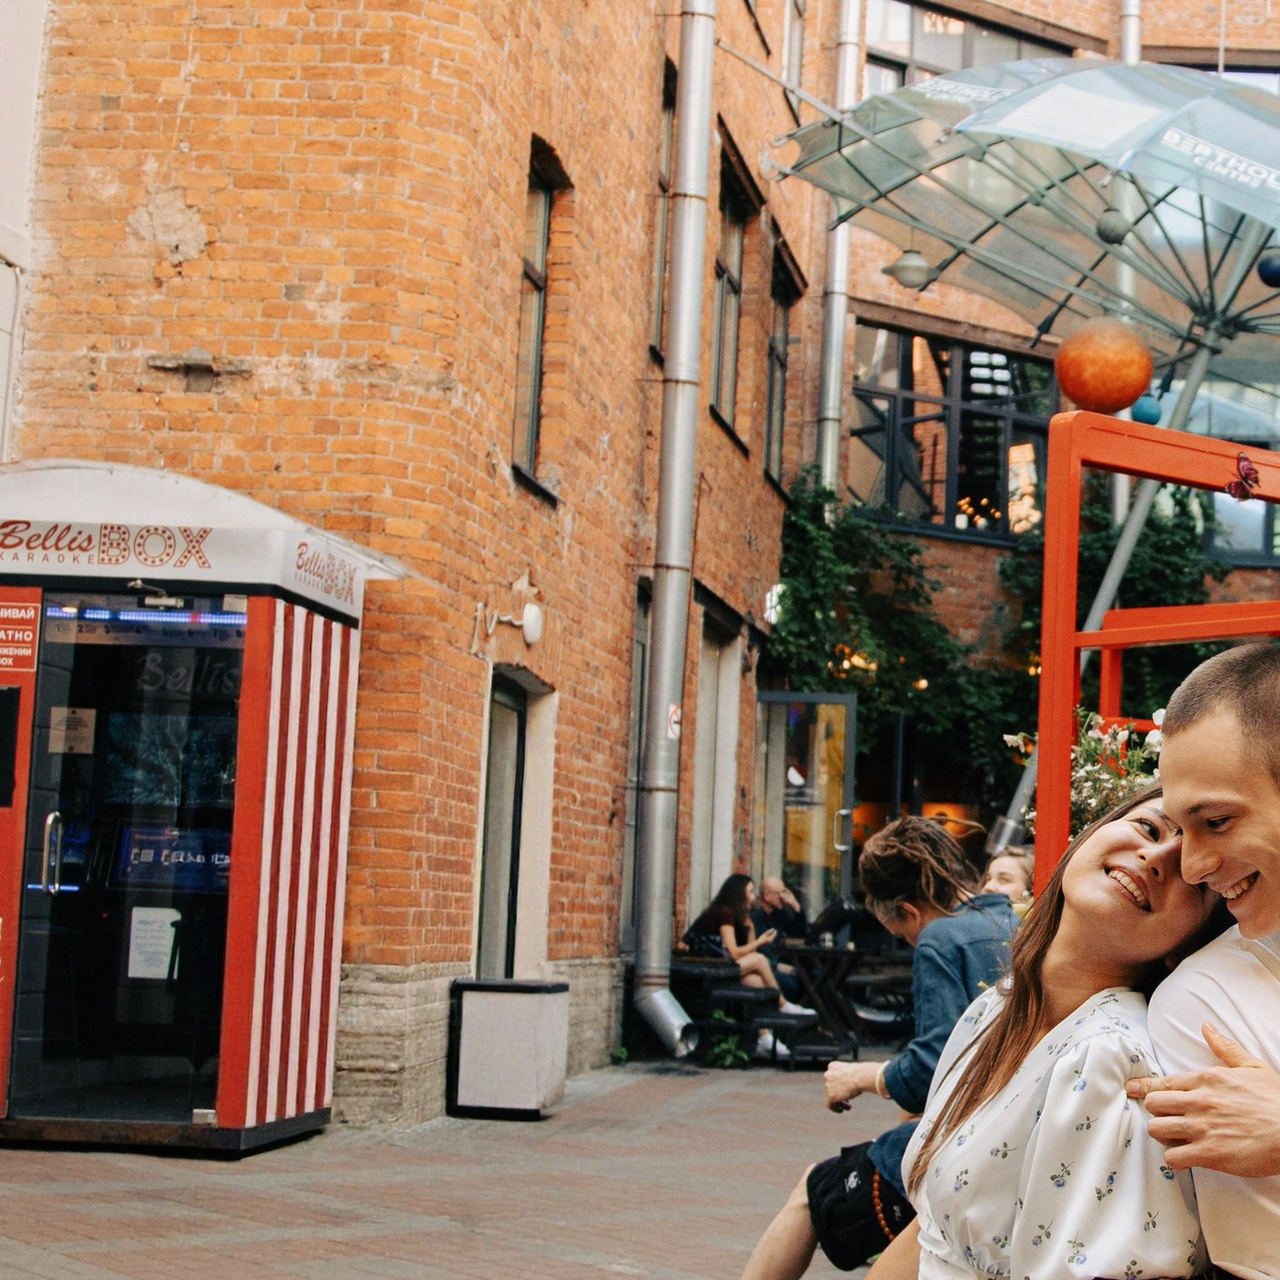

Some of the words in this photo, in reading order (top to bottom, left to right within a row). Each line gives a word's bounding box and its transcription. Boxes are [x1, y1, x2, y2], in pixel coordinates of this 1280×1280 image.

[0, 520, 95, 552] Bellis
[97, 523, 213, 569] BOX
[296, 541, 326, 580] Bellis
[323, 553, 357, 605] BOX
